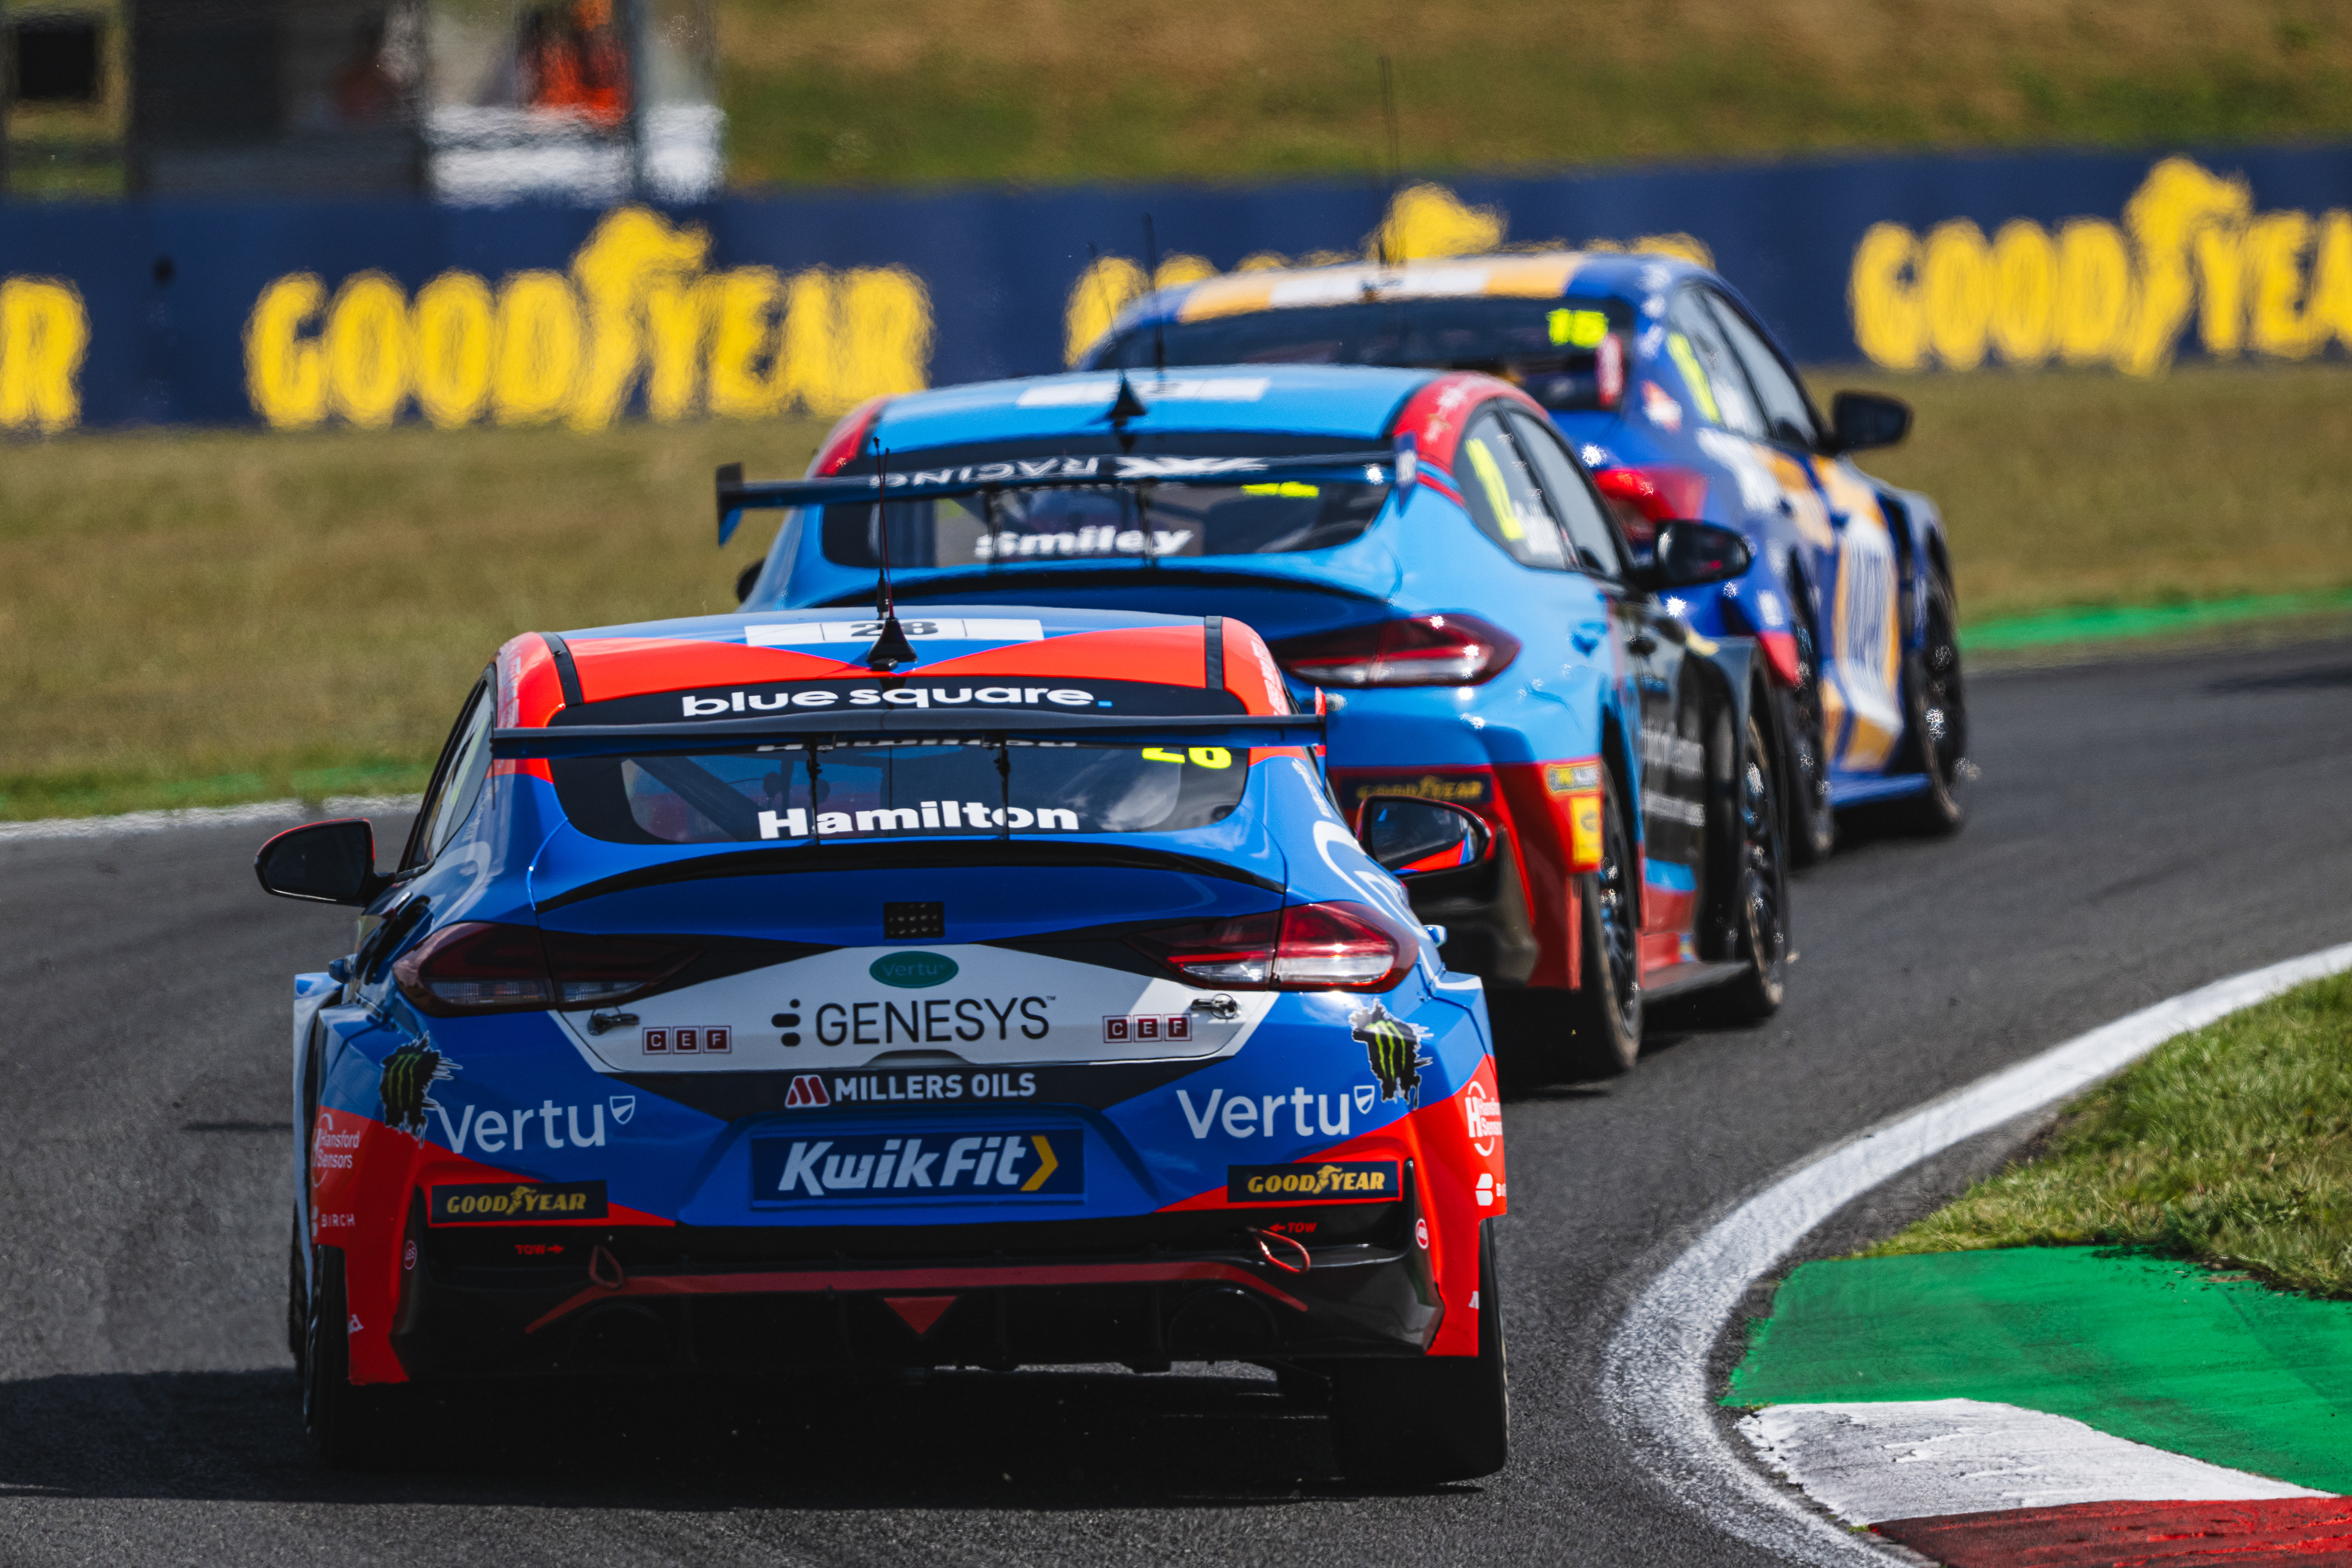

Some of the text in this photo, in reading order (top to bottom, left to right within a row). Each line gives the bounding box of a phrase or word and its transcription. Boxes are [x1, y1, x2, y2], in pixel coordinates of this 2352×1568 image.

[245, 263, 934, 434] GOODYEAR
[682, 692, 839, 717] blue
[758, 800, 1079, 840] Hamilton
[816, 997, 1049, 1046] GENESYS
[835, 1072, 1036, 1101] MILLERS OILS
[436, 1099, 606, 1154] Vertu
[1176, 1087, 1349, 1139] Vertu
[1248, 1172, 1385, 1193] GOODYEAR
[447, 1193, 586, 1213] GOODYEAR
[322, 1213, 356, 1227] BIRCH
[1287, 1221, 1317, 1233] TOW
[515, 1244, 546, 1256] TOW
